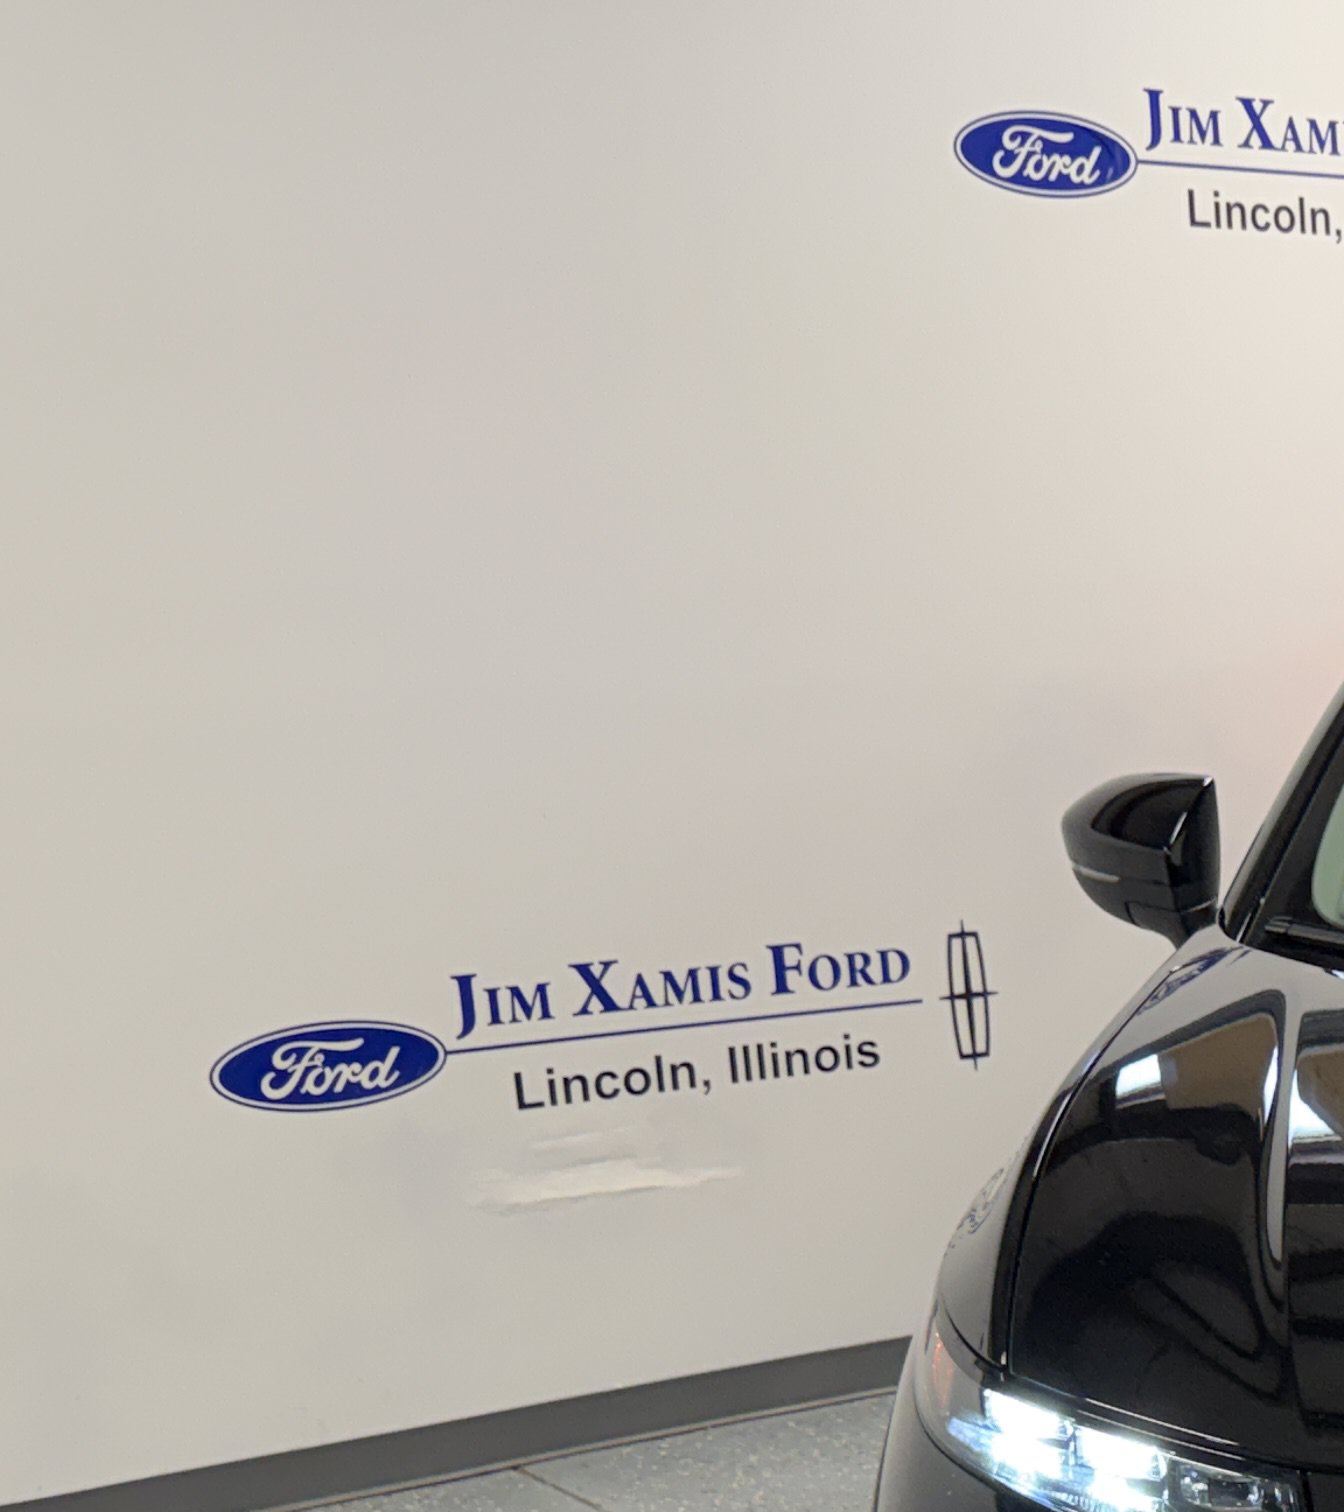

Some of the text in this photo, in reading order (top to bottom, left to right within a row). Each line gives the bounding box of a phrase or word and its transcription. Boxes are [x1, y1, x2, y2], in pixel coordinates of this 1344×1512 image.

[1142, 88, 1222, 151] JIM
[992, 125, 1102, 186] Ford
[1187, 189, 1342, 243] Lincoln,
[450, 942, 910, 1040] JIM XAMIS FORD
[260, 1037, 400, 1099] Ford
[515, 1034, 879, 1110] Lincoln, Illinois
